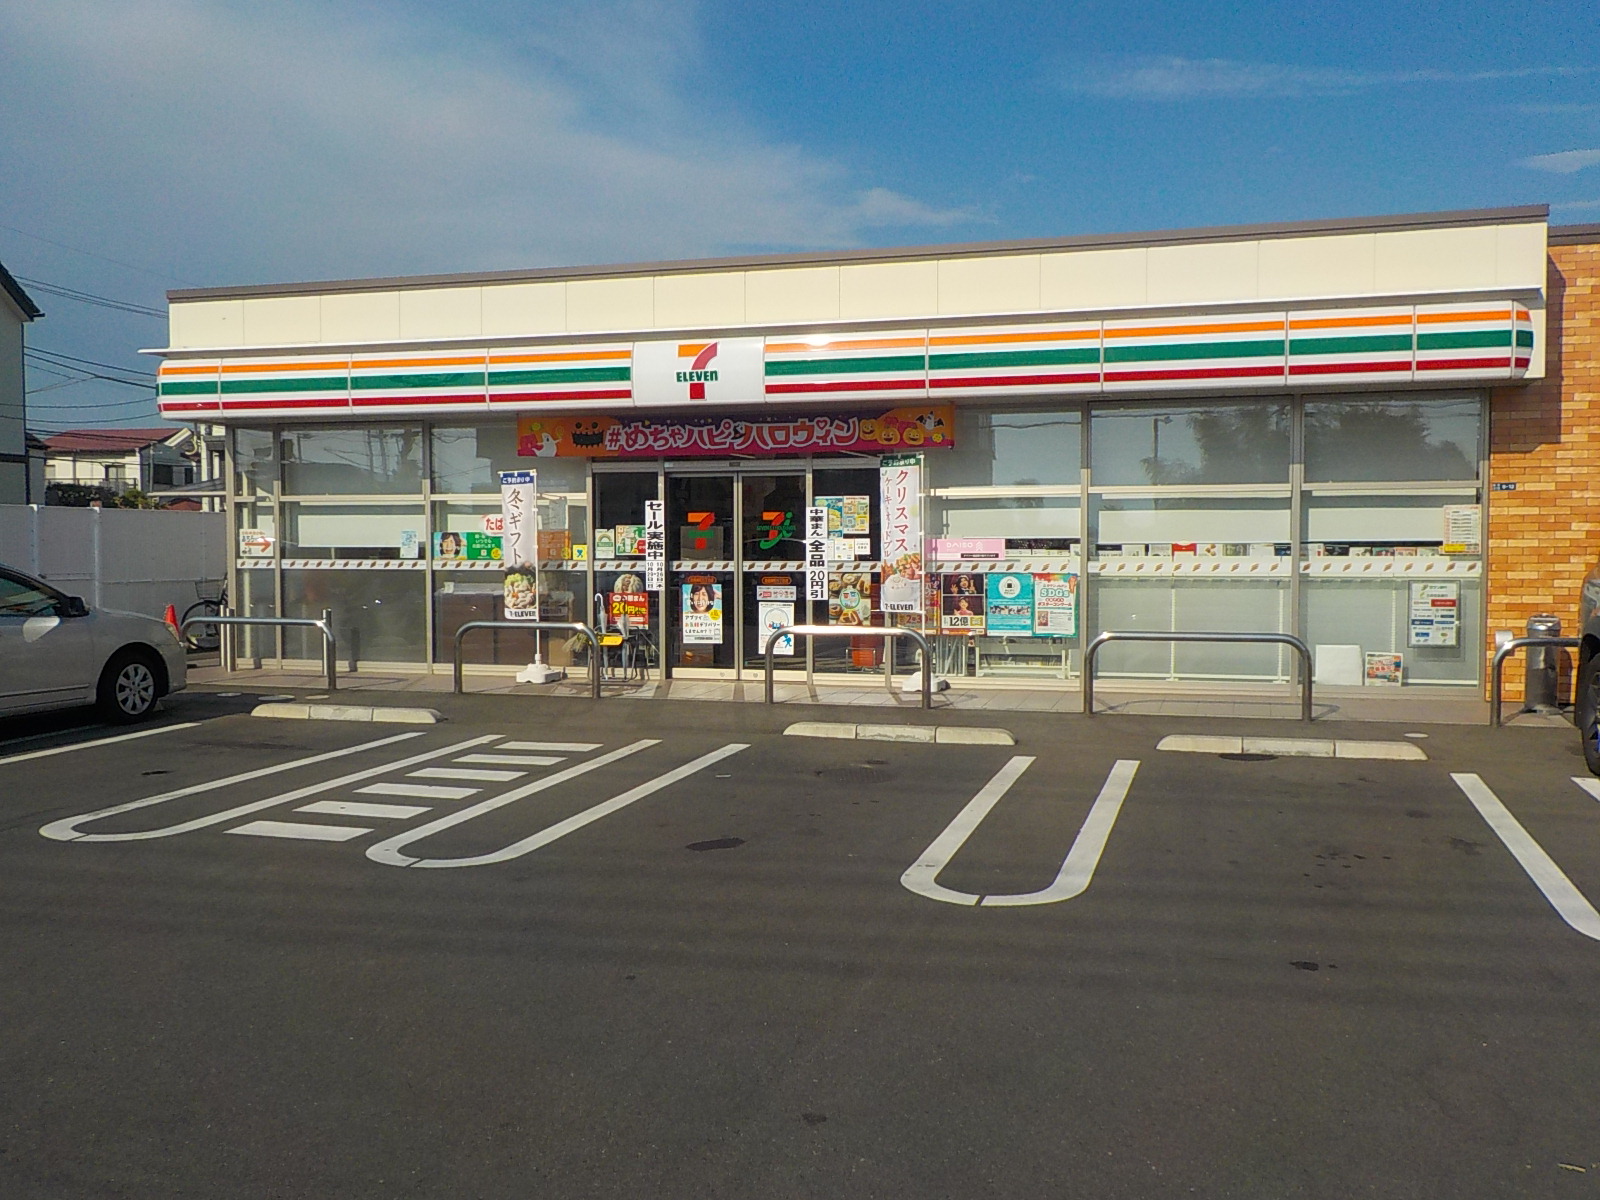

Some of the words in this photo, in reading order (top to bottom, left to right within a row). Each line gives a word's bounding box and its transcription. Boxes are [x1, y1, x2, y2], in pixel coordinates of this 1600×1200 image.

[507, 488, 524, 565] 冬ギフト
[646, 501, 664, 560] セール実施中
[893, 469, 910, 552] クリスマス
[1041, 588, 1070, 598] SDGs
